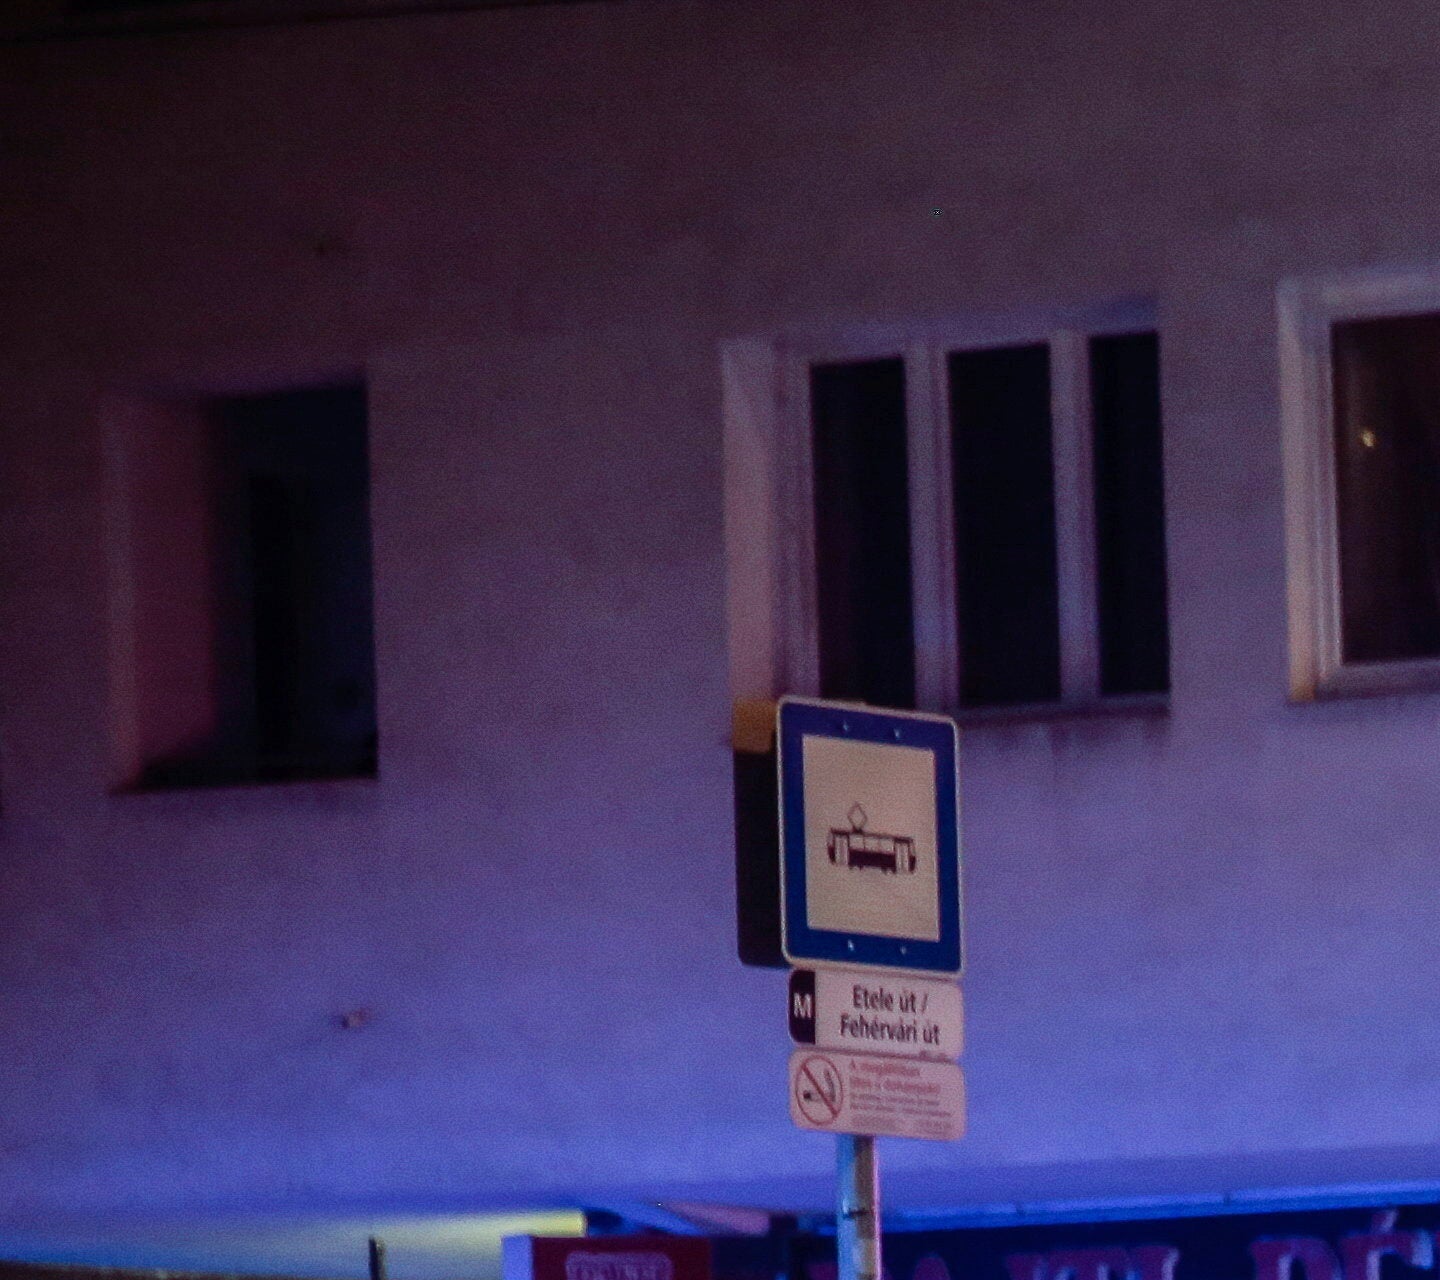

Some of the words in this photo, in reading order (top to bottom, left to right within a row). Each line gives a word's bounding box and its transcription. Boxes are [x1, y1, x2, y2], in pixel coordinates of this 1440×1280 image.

[853, 984, 893, 1012] Etele
[899, 986, 916, 1013] út
[840, 1012, 917, 1043] Fehérvári
[922, 1019, 940, 1045] út
